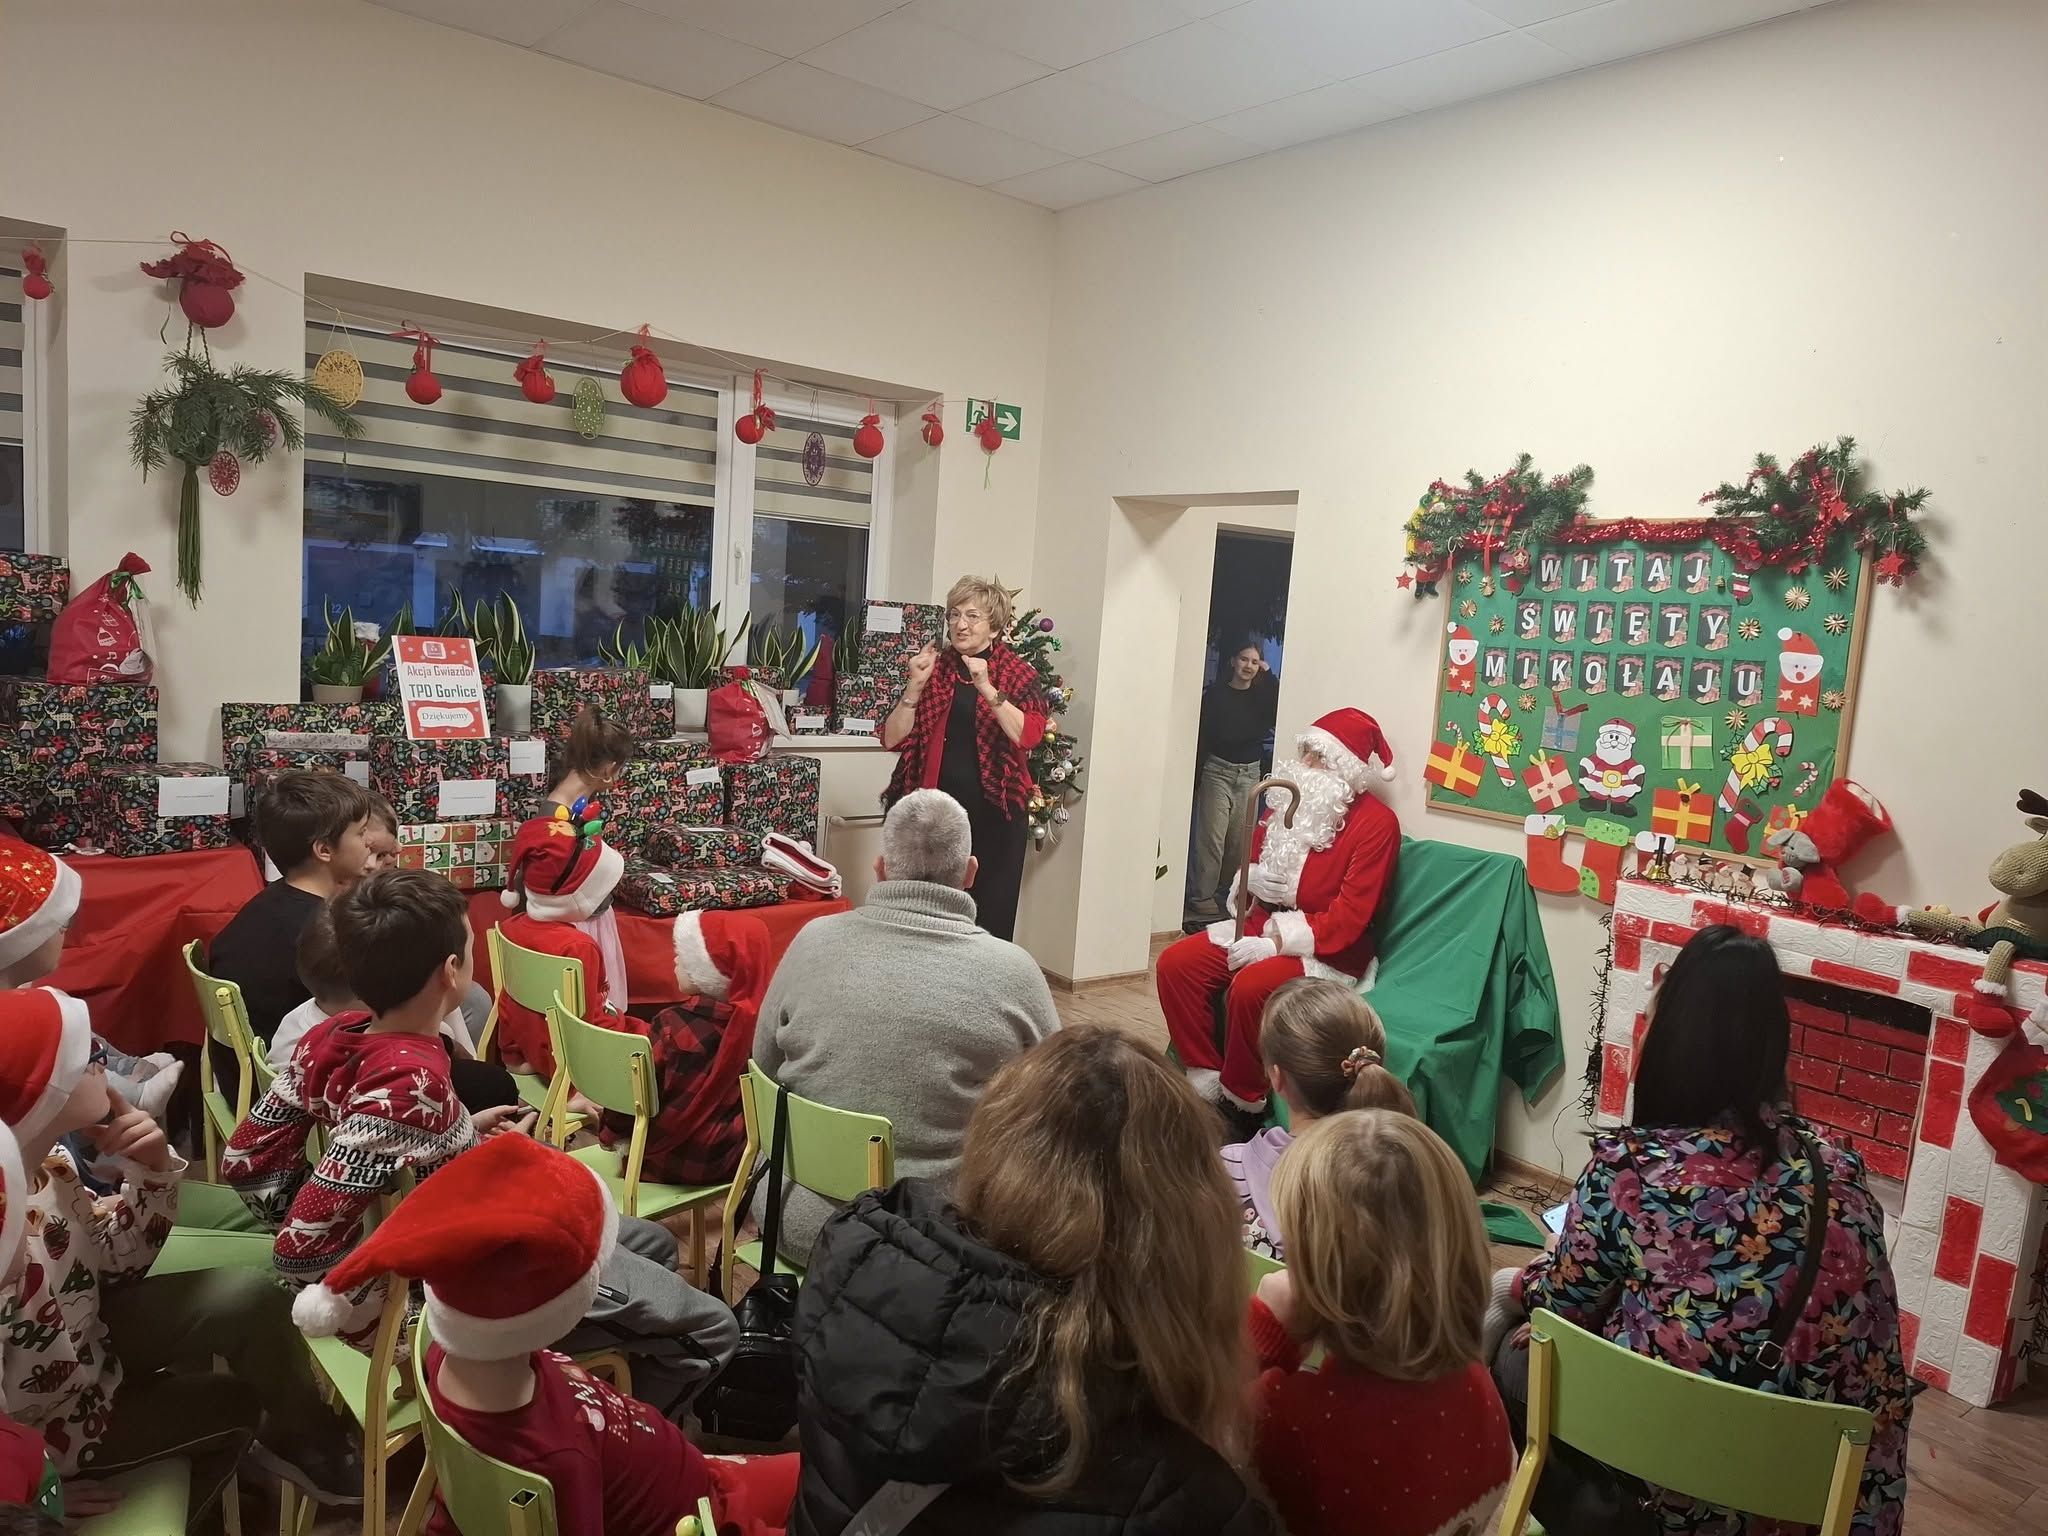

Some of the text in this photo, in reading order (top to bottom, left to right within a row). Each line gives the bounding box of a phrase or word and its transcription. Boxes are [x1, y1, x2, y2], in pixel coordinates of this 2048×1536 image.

[1540, 557, 1704, 584] WITAJ
[1520, 603, 1725, 642] ŚWIĘTY
[407, 665, 432, 679] Akcja
[1485, 655, 1756, 697] MIKOŁAJU
[409, 684, 477, 698] TPD Gorlice
[422, 711, 469, 722] Dziękujemy
[318, 1157, 348, 1180] UN
[326, 1142, 398, 1170] UDOLPH
